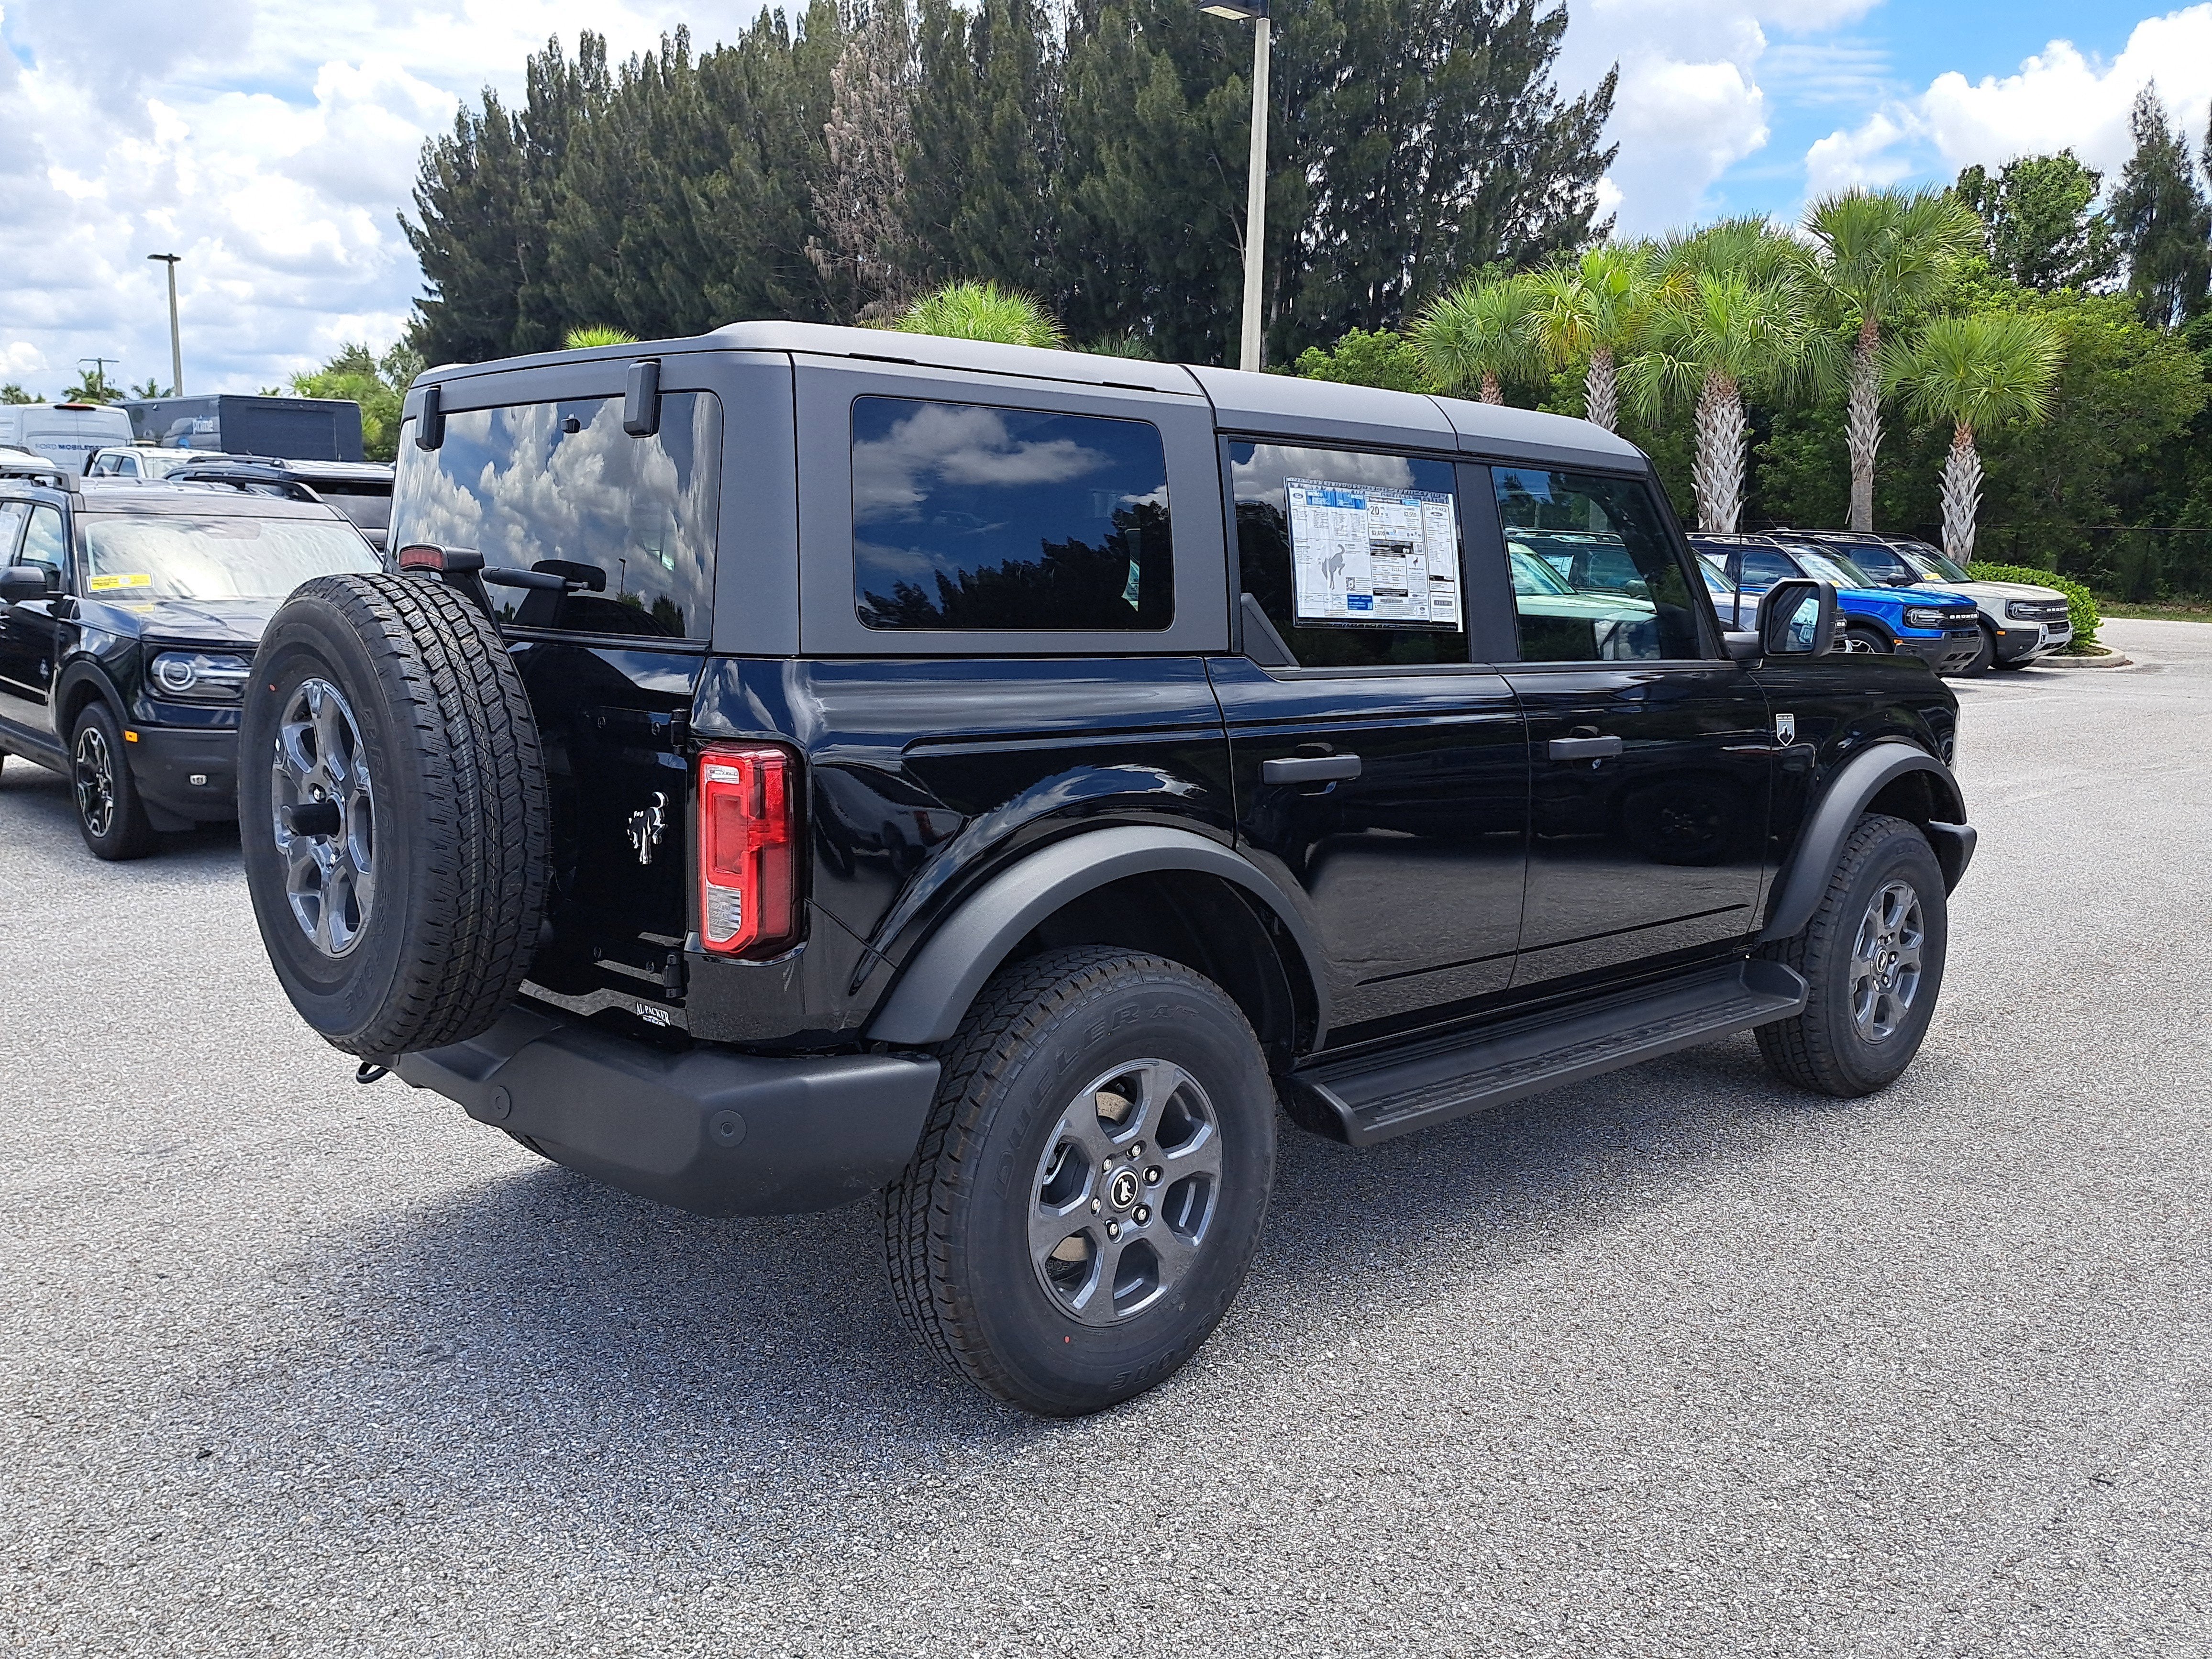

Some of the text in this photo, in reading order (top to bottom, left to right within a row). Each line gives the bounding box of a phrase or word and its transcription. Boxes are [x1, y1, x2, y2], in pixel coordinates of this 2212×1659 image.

[1370, 506, 1380, 515] 20
[637, 1001, 671, 1026] AL PACKER
